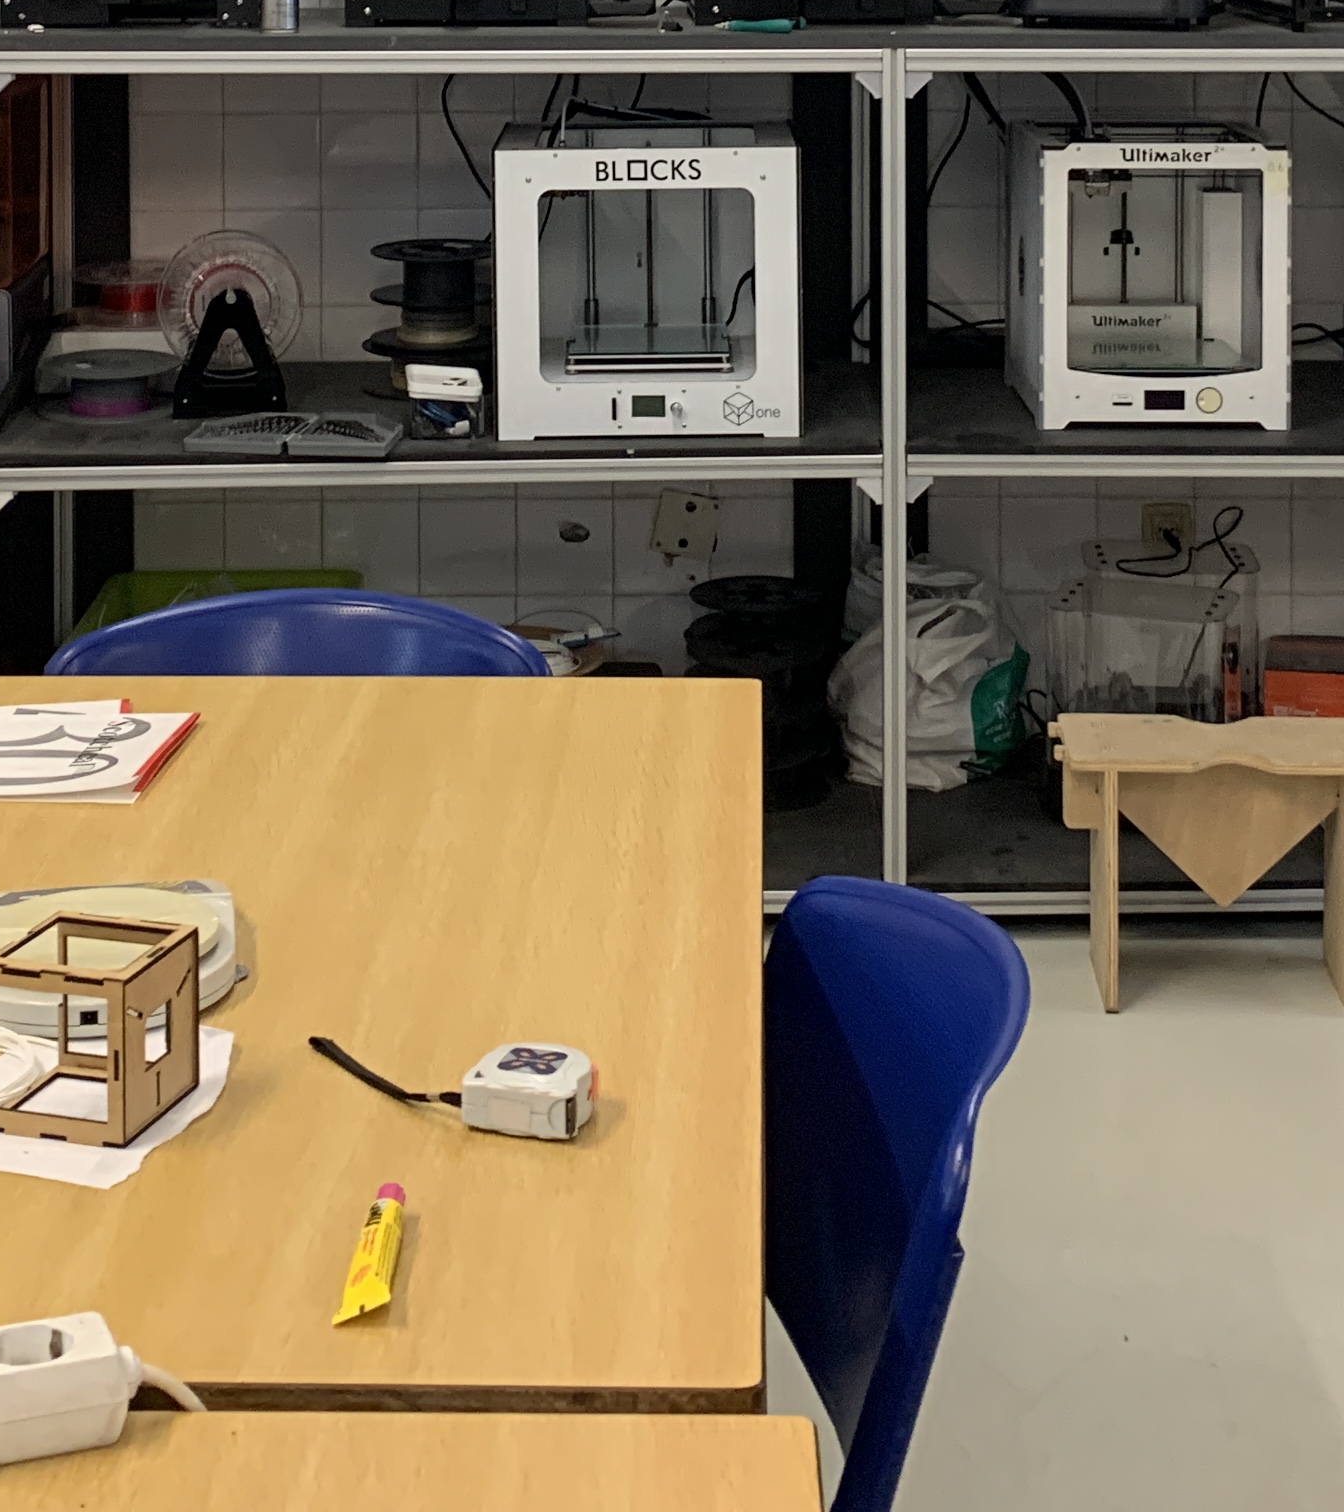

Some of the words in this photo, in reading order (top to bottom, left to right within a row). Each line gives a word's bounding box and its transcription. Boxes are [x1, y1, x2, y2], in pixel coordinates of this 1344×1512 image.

[1120, 148, 1212, 162] Ultimaker
[595, 159, 702, 181] BLOCKS
[1091, 315, 1162, 327] Ultimaker
[756, 407, 781, 418] one
